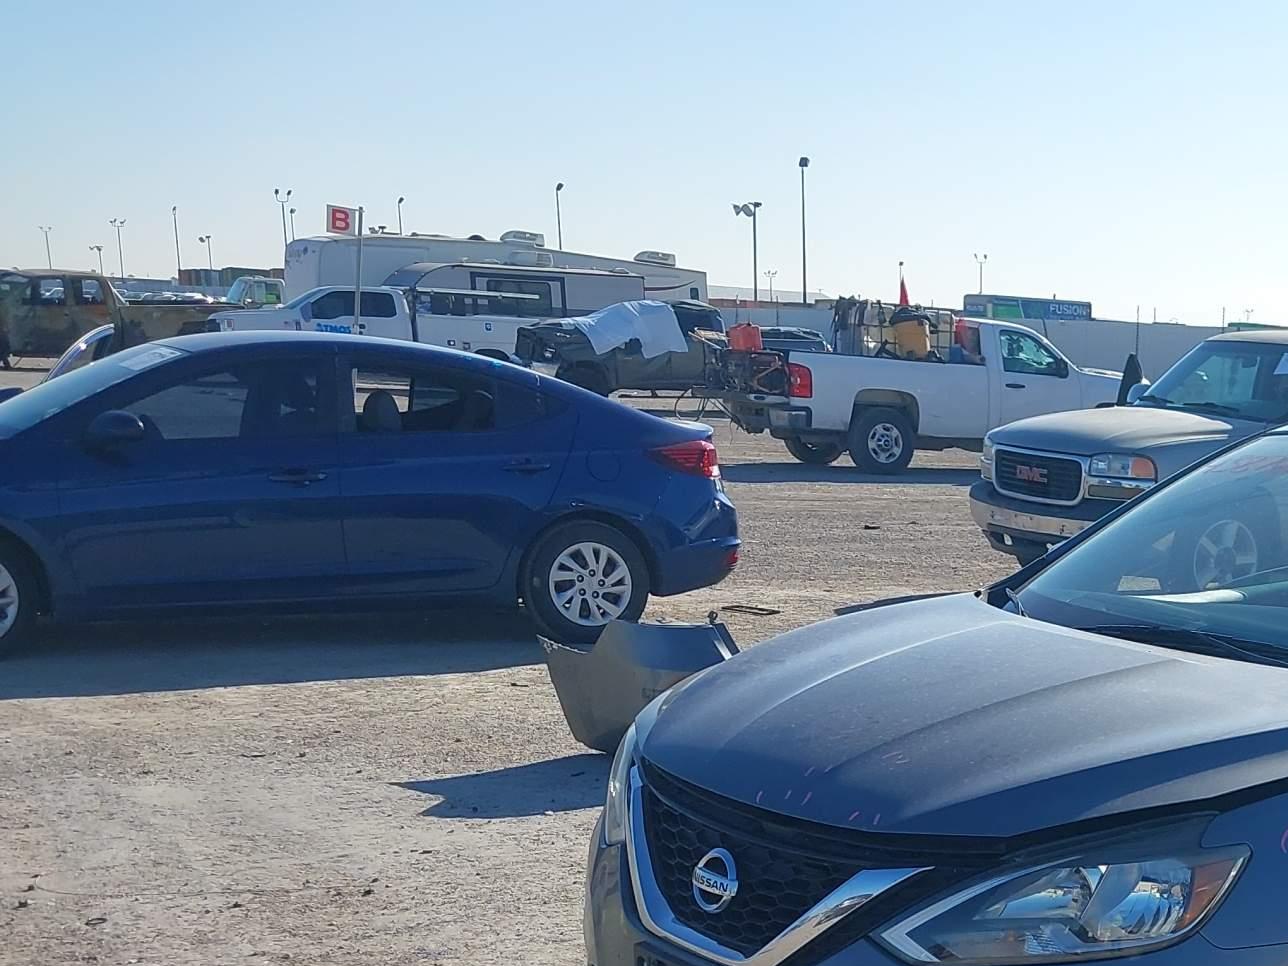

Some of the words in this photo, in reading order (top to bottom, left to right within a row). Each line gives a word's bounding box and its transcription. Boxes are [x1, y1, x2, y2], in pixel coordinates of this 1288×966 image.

[331, 208, 350, 231] B
[1049, 303, 1087, 316] FUSION
[1016, 465, 1048, 483] GMC
[693, 868, 730, 893] NISSAN
